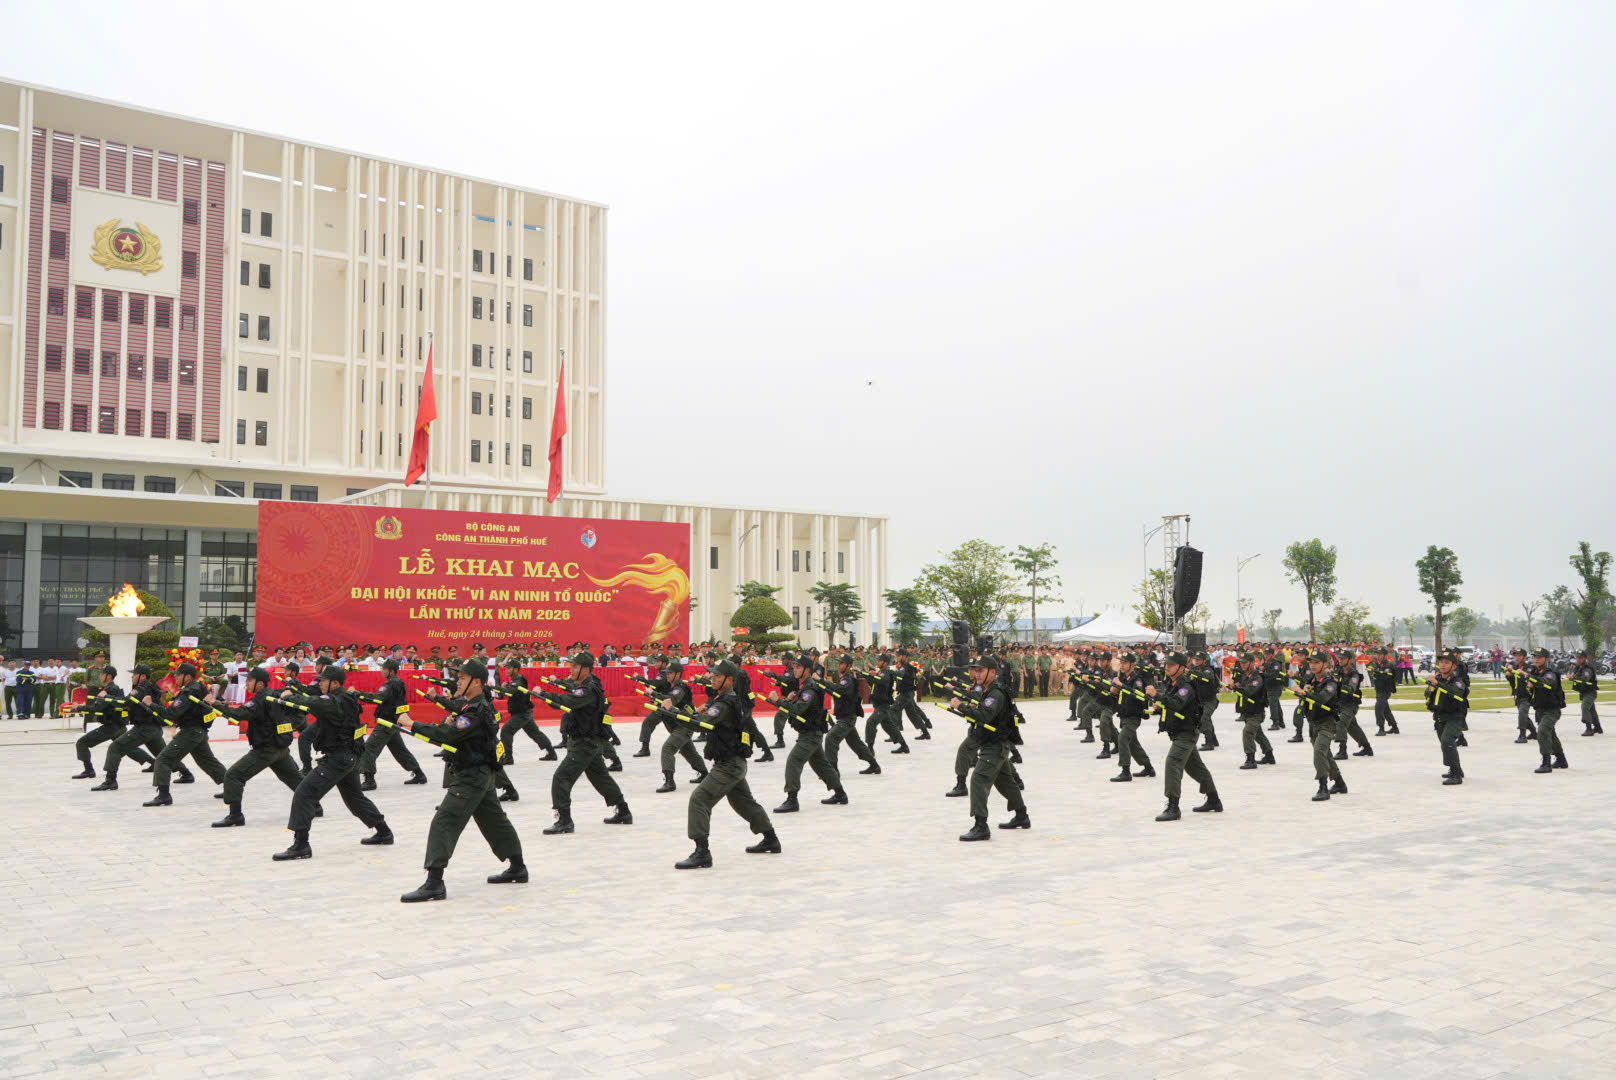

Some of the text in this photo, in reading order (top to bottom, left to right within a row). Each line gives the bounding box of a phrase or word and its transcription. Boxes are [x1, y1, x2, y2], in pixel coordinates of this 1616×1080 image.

[465, 521, 521, 533] BỘ CÔNG AN
[435, 532, 549, 546] CÔNG AN THÀNH PHỐ HUẾ
[399, 548, 581, 582] LỄ KHAI MẠC
[351, 587, 379, 602] ĐẠI
[384, 586, 412, 602] HỘI
[416, 585, 457, 601] KHỎE
[489, 590, 510, 601] AN
[514, 590, 551, 602] NINH
[554, 587, 572, 602] TỔ
[409, 604, 572, 621] LẦN THỨ IX NĂM 2026
[427, 629, 553, 640] Huế, ngày 24 tháng 3 năm 2026
